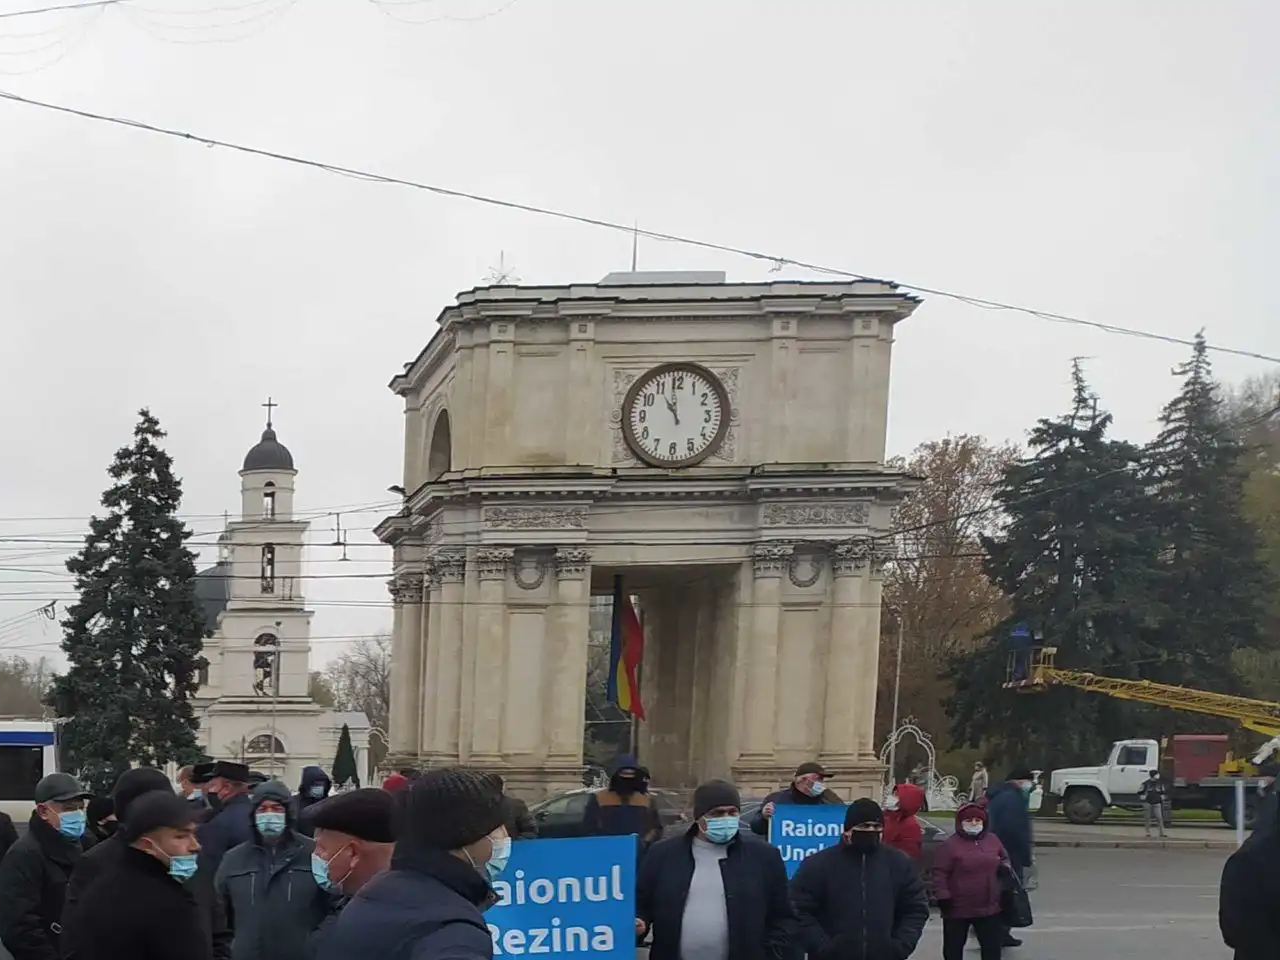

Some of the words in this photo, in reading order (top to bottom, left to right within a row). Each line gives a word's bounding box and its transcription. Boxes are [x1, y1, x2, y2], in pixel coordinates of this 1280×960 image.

[656, 381, 666, 395] 11
[691, 381, 697, 396] 1
[642, 392, 655, 407] 10
[700, 392, 708, 406] 2
[638, 409, 646, 423] 9
[704, 409, 712, 423] 3
[641, 426, 649, 440] 8
[653, 438, 661, 451] 7
[668, 442, 677, 456] 6
[686, 438, 694, 452] 5
[491, 864, 625, 906] aionul
